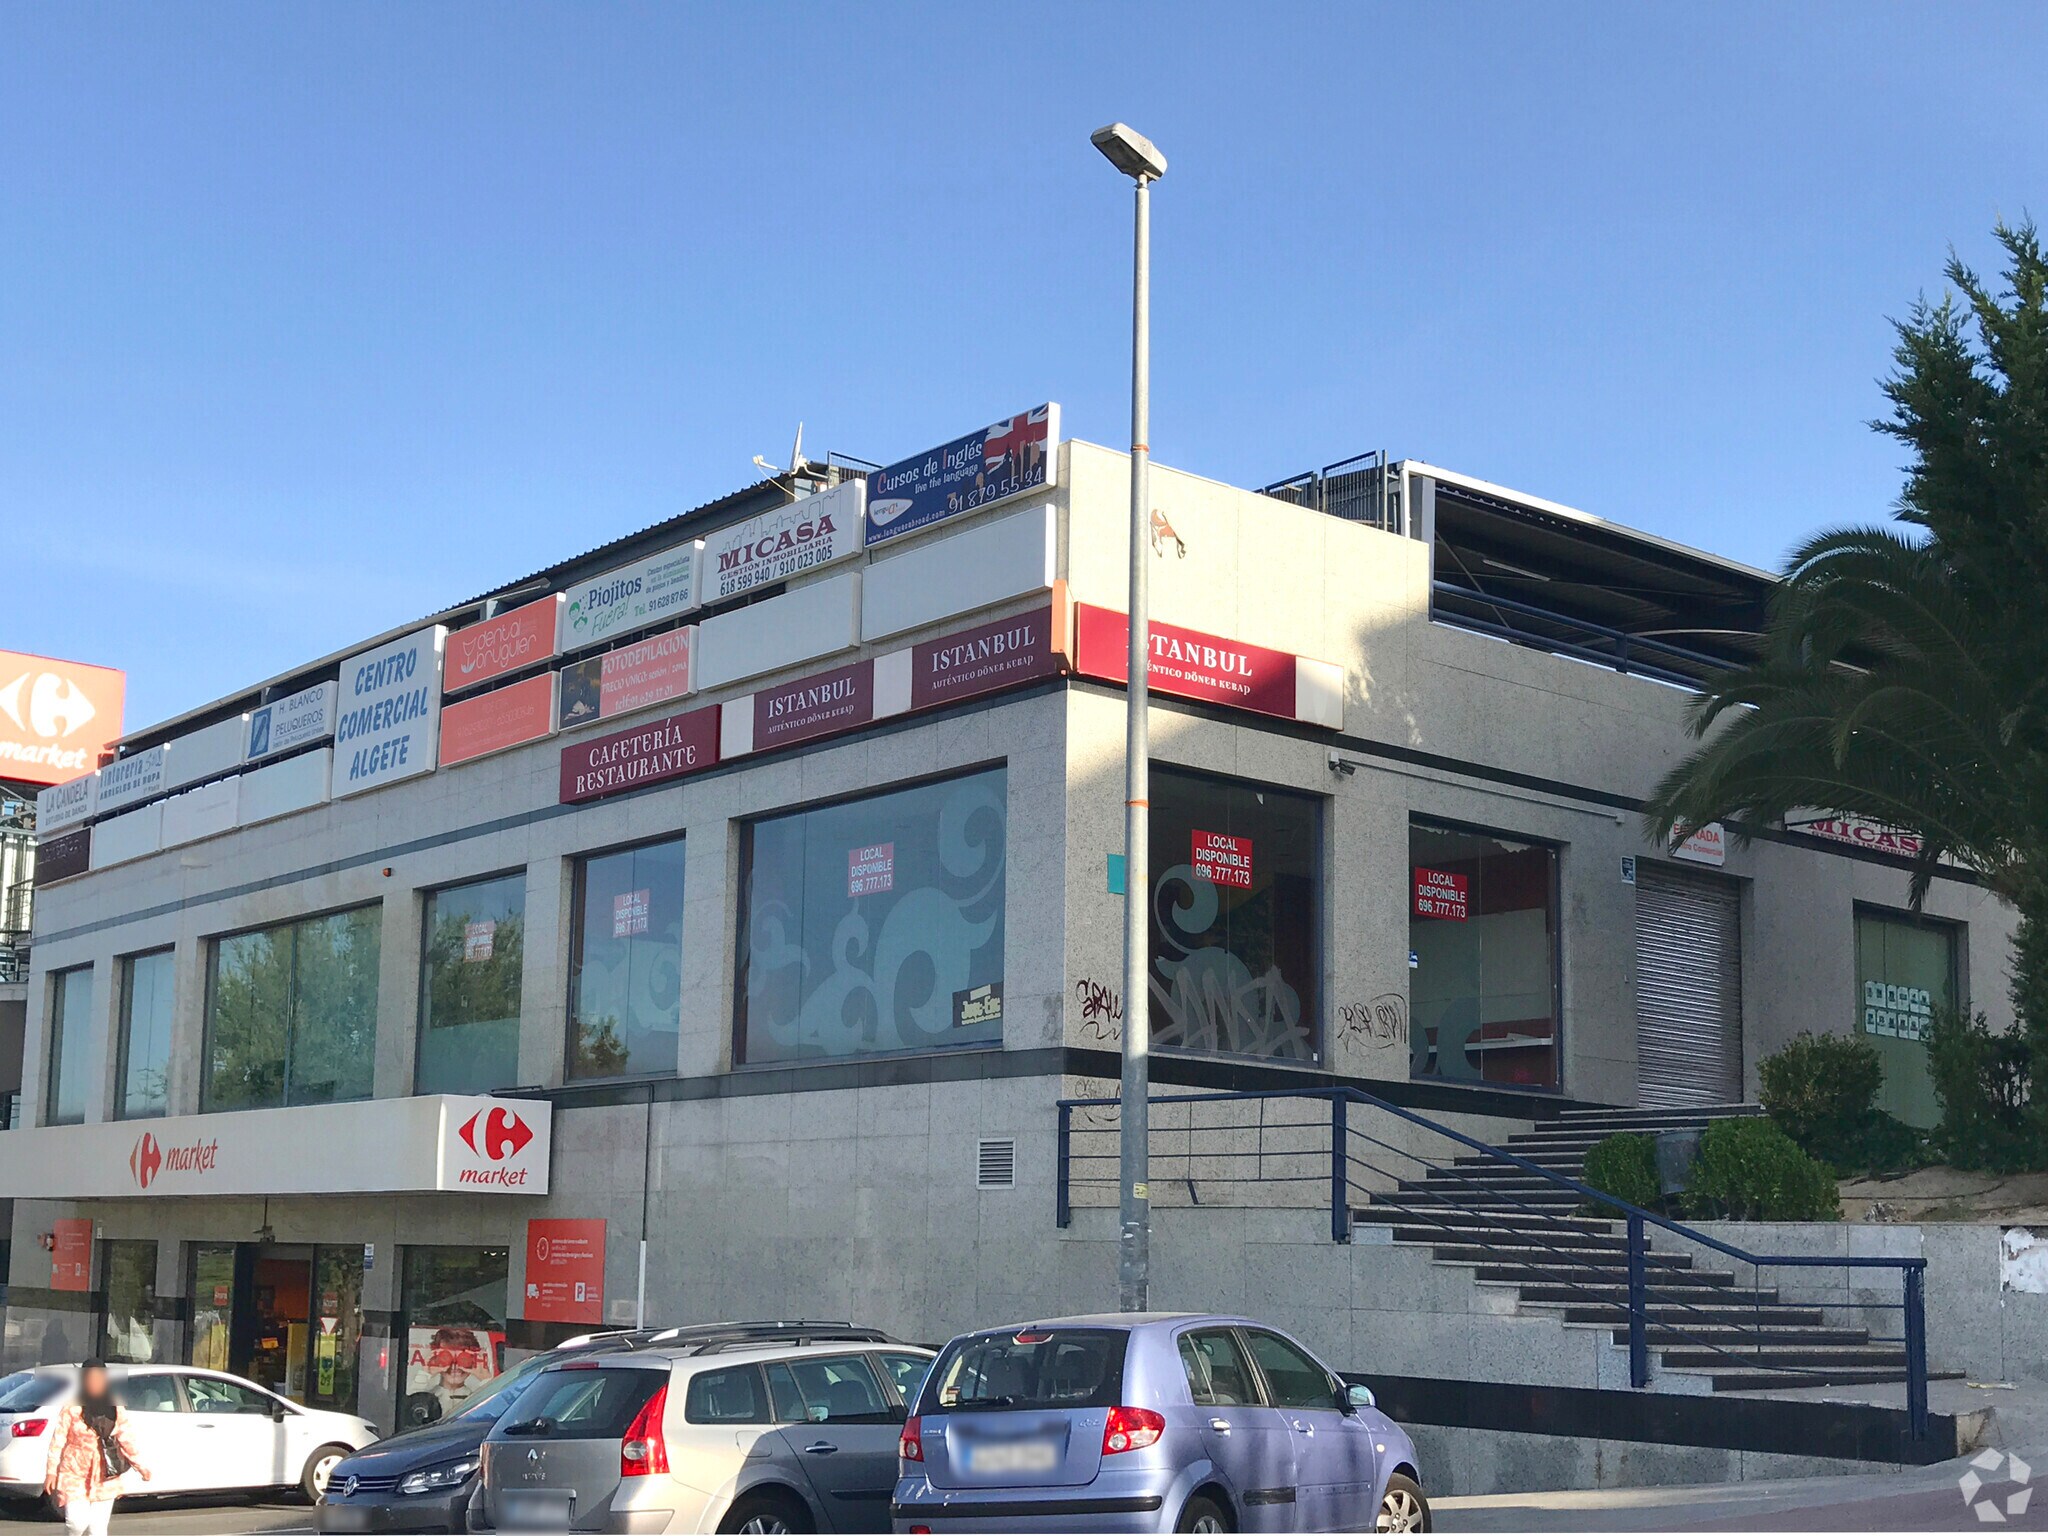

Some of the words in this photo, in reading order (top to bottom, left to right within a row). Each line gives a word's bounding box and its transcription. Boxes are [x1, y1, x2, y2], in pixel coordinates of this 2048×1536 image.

[877, 469, 919, 494] Cursos
[924, 457, 938, 476] de
[942, 440, 982, 470] Inglés
[929, 478, 942, 488] the
[943, 463, 979, 483] language
[949, 495, 963, 514] 91
[968, 484, 996, 506] 879
[1000, 476, 1020, 495] 55
[1025, 466, 1043, 487] 34
[718, 514, 837, 574] MICASA
[720, 561, 760, 581] GESTIÓN
[762, 536, 833, 566] INMOBILIARIA
[720, 578, 735, 596] 618
[737, 573, 752, 590] 599
[755, 566, 770, 584] 940
[772, 564, 777, 578] /
[780, 558, 796, 576] 910
[798, 551, 813, 569] 023
[816, 545, 833, 563] 005
[588, 576, 642, 610] Piojitos
[592, 595, 630, 636] Fuera!
[478, 617, 521, 650] dental
[932, 624, 1035, 673] ISTANBUL
[602, 632, 689, 676] FOTODEPILACIÓN
[1126, 628, 1253, 677] TANBUL
[355, 648, 417, 696] CENTRO
[932, 671, 975, 690] AUTÉNTICO
[977, 662, 1004, 677] DÖNER
[1006, 654, 1034, 670] KEBAP
[1184, 670, 1217, 687] DÖNER
[1219, 679, 1251, 696] KEBAP
[279, 704, 287, 715] H.
[289, 688, 323, 711] BLANCO
[338, 686, 428, 743] COMERCIAL
[768, 677, 856, 719] ISTANBUL
[275, 708, 323, 736] PELUQUEROS
[768, 718, 806, 735] AUTÉNTICO
[807, 710, 831, 724] DÖNER
[832, 704, 854, 717] KEBAP
[0, 740, 88, 769] market
[350, 735, 410, 780] ALGETE
[589, 718, 683, 768] CAFETERÍA
[100, 780, 131, 801] ARREGLOS
[142, 771, 160, 787] ROPA
[575, 745, 697, 795] RESTAURANTE
[46, 789, 56, 813] LA
[57, 778, 89, 811] CANDELA
[1207, 835, 1238, 851] LOCAL
[1807, 819, 1921, 853] MICAS
[851, 859, 892, 877] DISPONIBLE
[860, 846, 884, 861] LOCAL
[1196, 848, 1250, 868] DISPONIBLE
[851, 873, 892, 893] 696.777.173
[1195, 863, 1250, 885] 696.777.173
[1428, 872, 1455, 887] LOCAL
[623, 893, 640, 906] LOCAL
[1418, 884, 1466, 902] DISPONIBLE
[1418, 899, 1466, 918] 696.777.173
[166, 1137, 218, 1175] market
[460, 1168, 528, 1188] market
